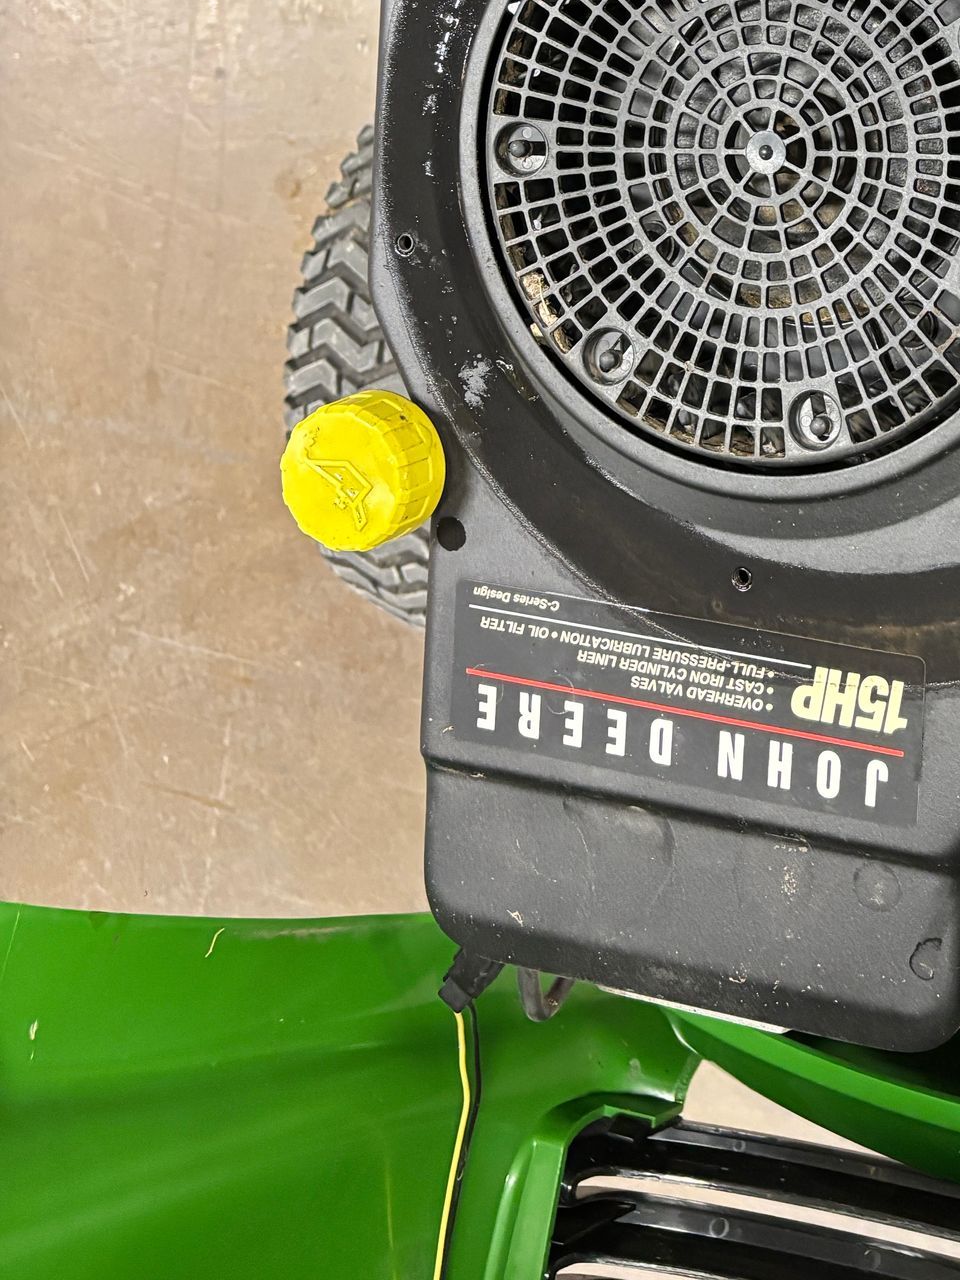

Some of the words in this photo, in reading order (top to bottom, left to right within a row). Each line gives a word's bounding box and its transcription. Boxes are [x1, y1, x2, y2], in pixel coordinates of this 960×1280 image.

[474, 586, 511, 603] Design
[514, 594, 560, 612] C-Series
[480, 616, 525, 634] FILTER
[529, 625, 549, 638] OIL
[560, 631, 650, 657] LUBRICATION
[577, 650, 616, 667] LINER
[614, 657, 687, 678] CYLINDER
[654, 648, 765, 678] FULL-PRESSURE
[631, 676, 683, 695] VALVES
[689, 672, 724, 689] IRON
[726, 678, 764, 694] CAST
[686, 686, 764, 711] OVERHEAD
[790, 666, 908, 734] 15HP
[477, 683, 673, 766] DEERE
[717, 730, 888, 808] JOHN
